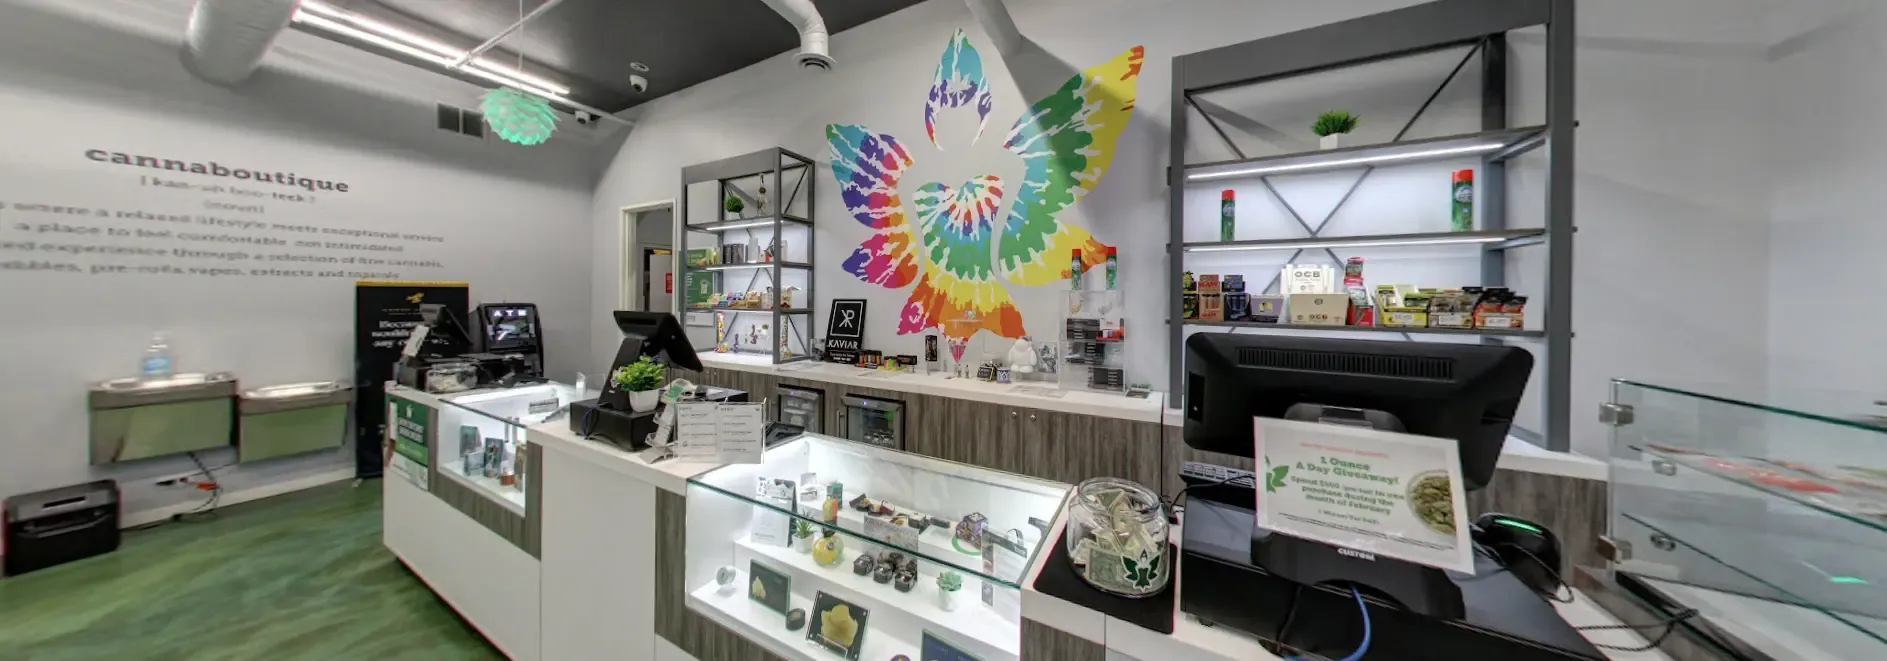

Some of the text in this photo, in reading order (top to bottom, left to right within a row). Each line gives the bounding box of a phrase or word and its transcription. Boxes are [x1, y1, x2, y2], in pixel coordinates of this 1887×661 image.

[85, 149, 350, 193] cannaboutique
[317, 270, 345, 278] and
[1294, 270, 1320, 278] OCB
[828, 338, 859, 350] KAVIAR
[1329, 457, 1371, 471] Ounce
[1296, 461, 1399, 485] A Day Giveaway!
[1343, 493, 1377, 505] during
[1378, 498, 1394, 507] the
[1348, 500, 1391, 516] February
